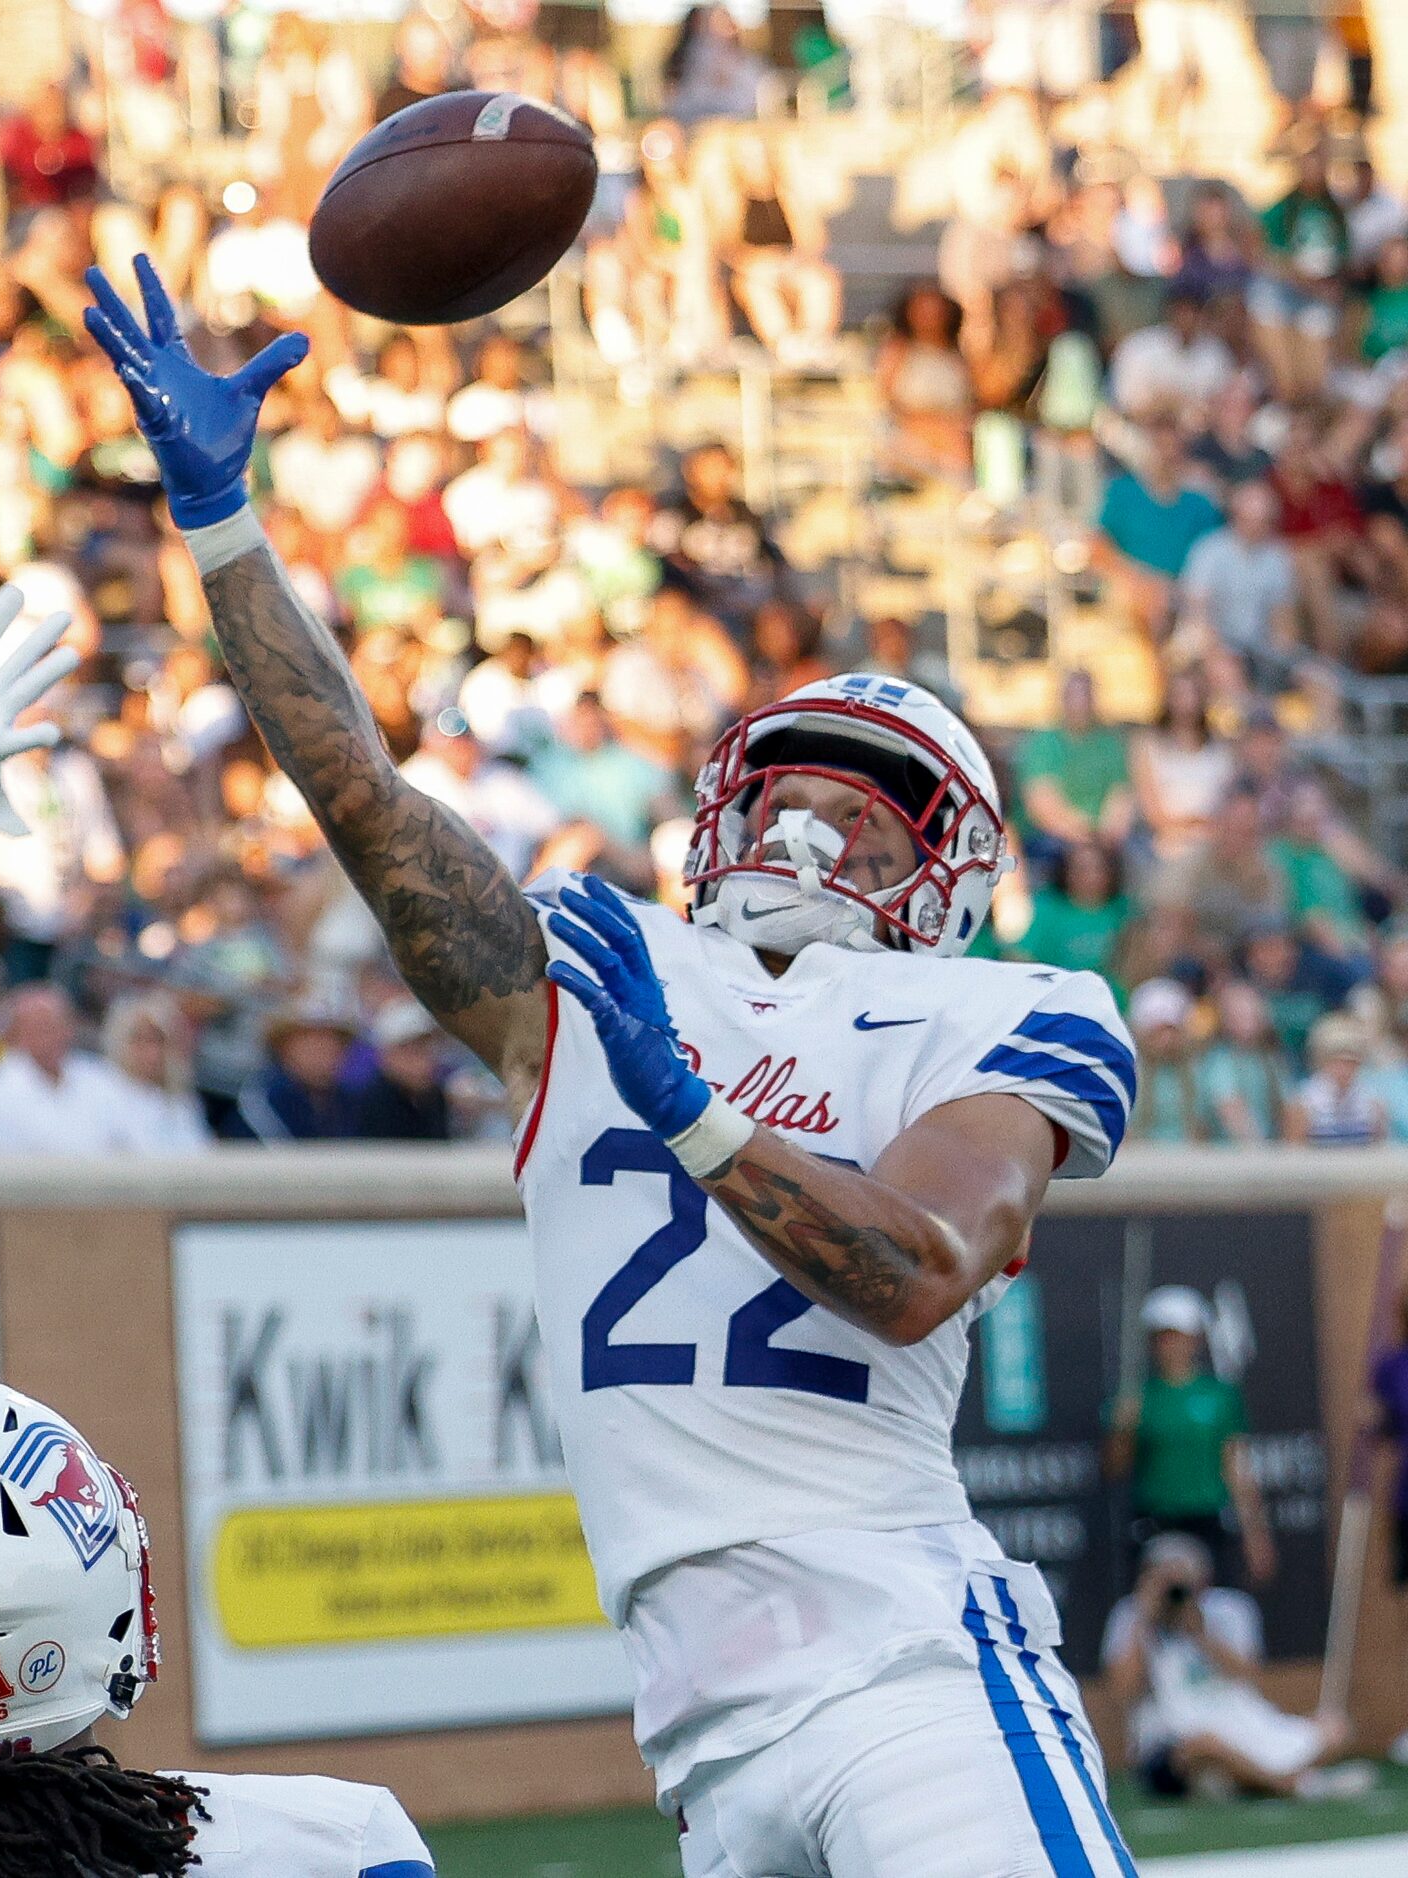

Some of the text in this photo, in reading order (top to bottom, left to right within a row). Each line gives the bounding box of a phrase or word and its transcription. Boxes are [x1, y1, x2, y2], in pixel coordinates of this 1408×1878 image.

[580, 1127, 870, 1404] 22
[220, 1298, 446, 1484] Kwik
[29, 1649, 58, 1685] PL
